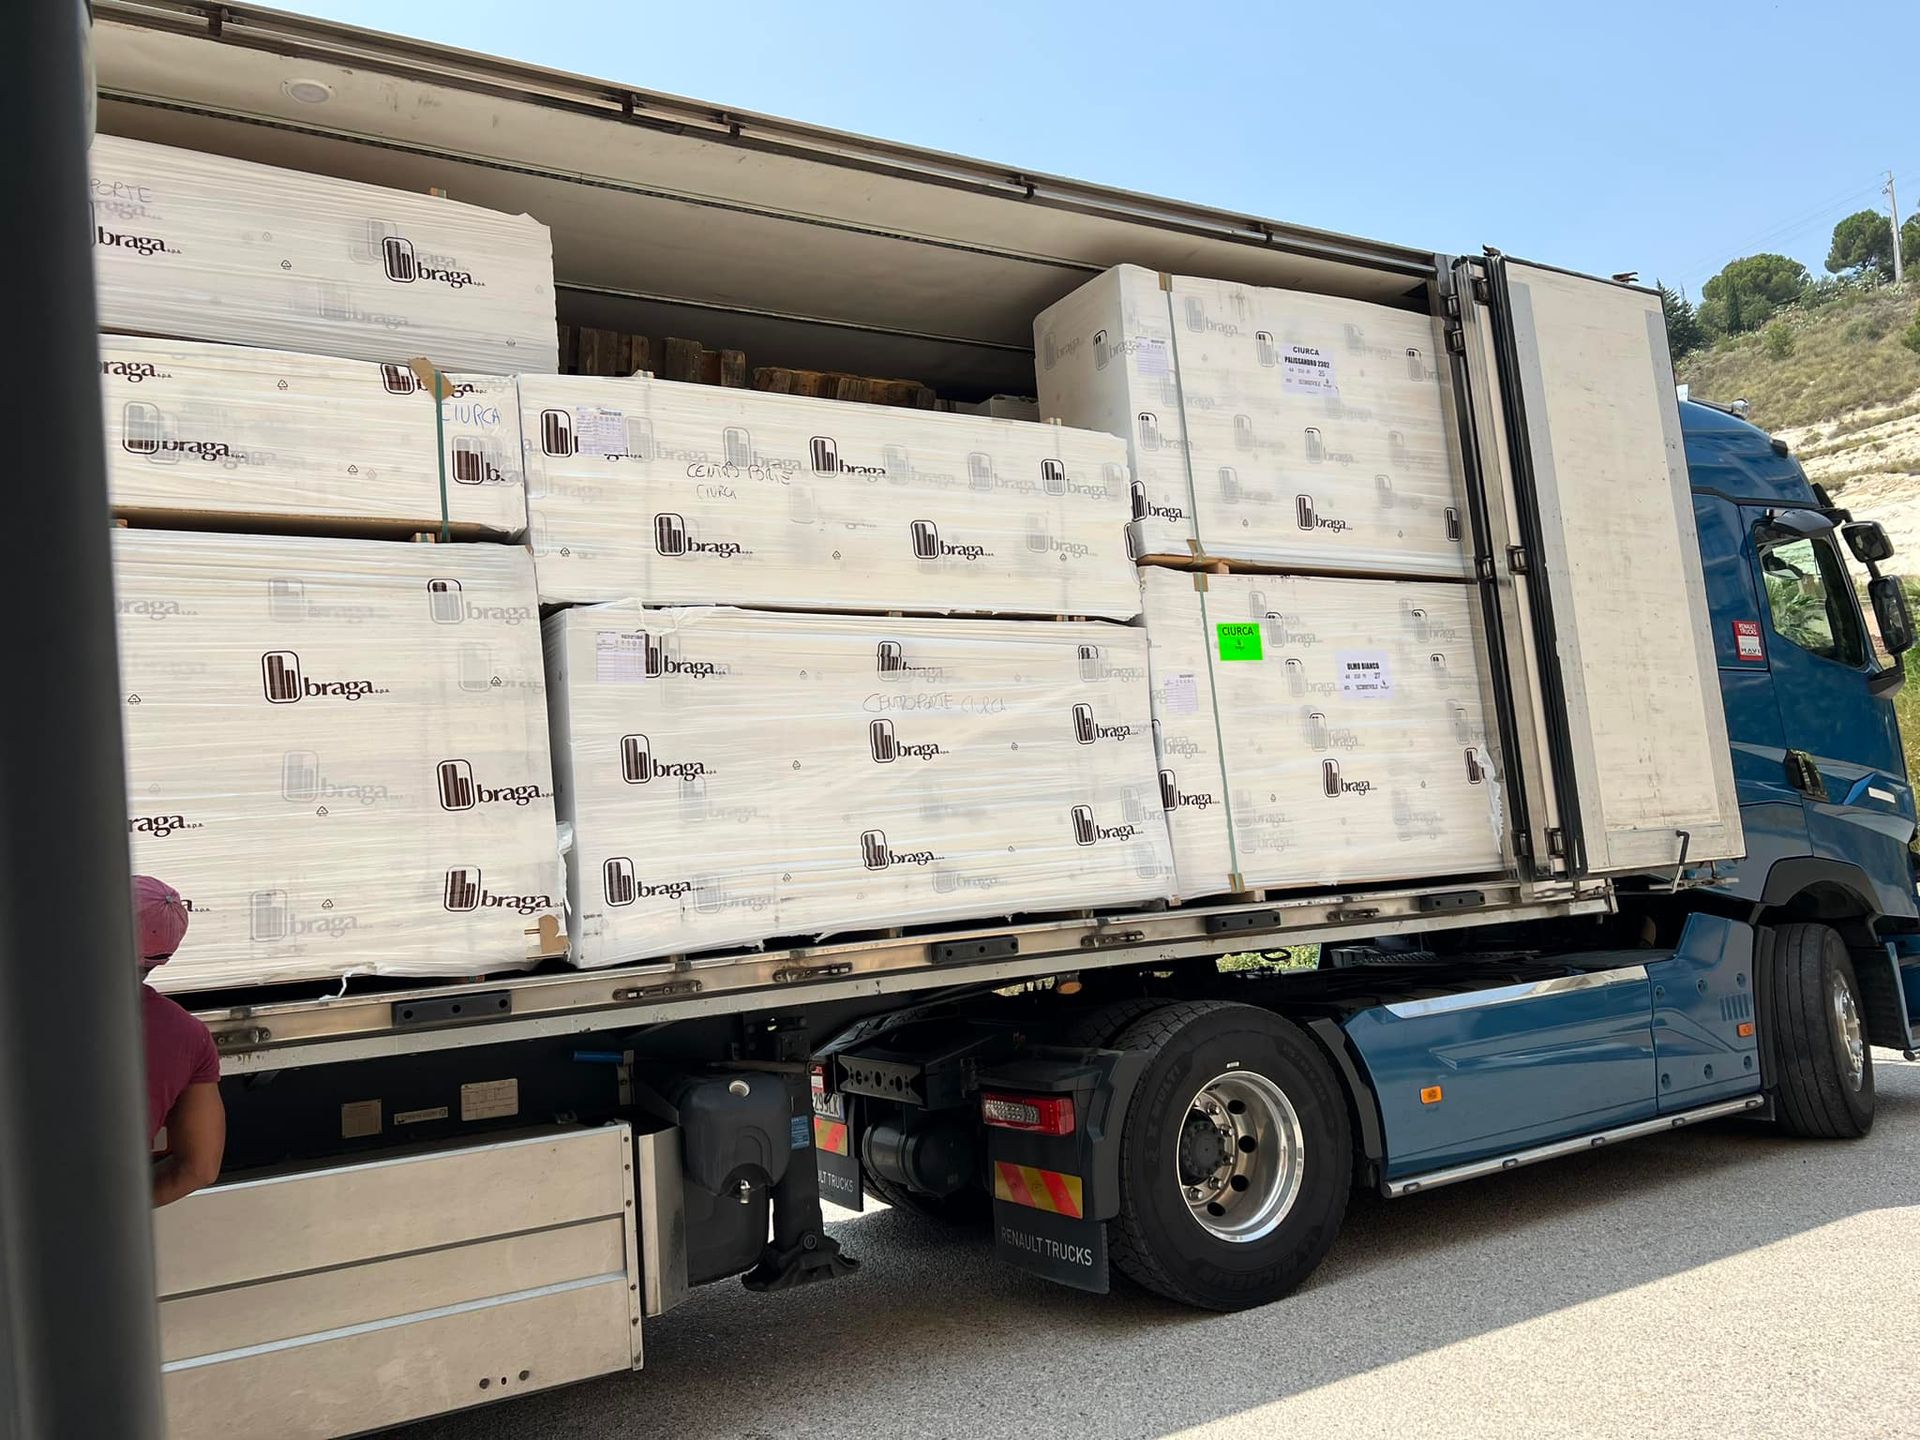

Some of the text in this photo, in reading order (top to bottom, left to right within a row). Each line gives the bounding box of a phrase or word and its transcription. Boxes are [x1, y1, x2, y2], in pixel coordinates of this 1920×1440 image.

[98, 226, 165, 256] braga
[417, 262, 473, 289] braga
[1292, 346, 1320, 356] CIURCA
[1148, 501, 1183, 522] braga
[1315, 514, 1346, 533] braga
[687, 536, 741, 558] braga
[940, 541, 984, 560] braga
[1222, 626, 1254, 636] CIURCA
[664, 655, 714, 679] braga
[303, 677, 374, 701] braga
[1095, 723, 1131, 741] braga
[896, 741, 940, 761] braga
[653, 759, 705, 782] braga
[476, 784, 541, 806] braga
[1340, 778, 1371, 796] braga
[1178, 790, 1212, 810] braga
[128, 814, 186, 838] raga
[1096, 825, 1135, 841] braga
[889, 850, 935, 866] braga
[637, 881, 691, 899] braga
[481, 889, 552, 915] braga
[827, 1172, 854, 1193] TRUCKS
[1001, 1226, 1093, 1267] RENAULT TRUCKS
